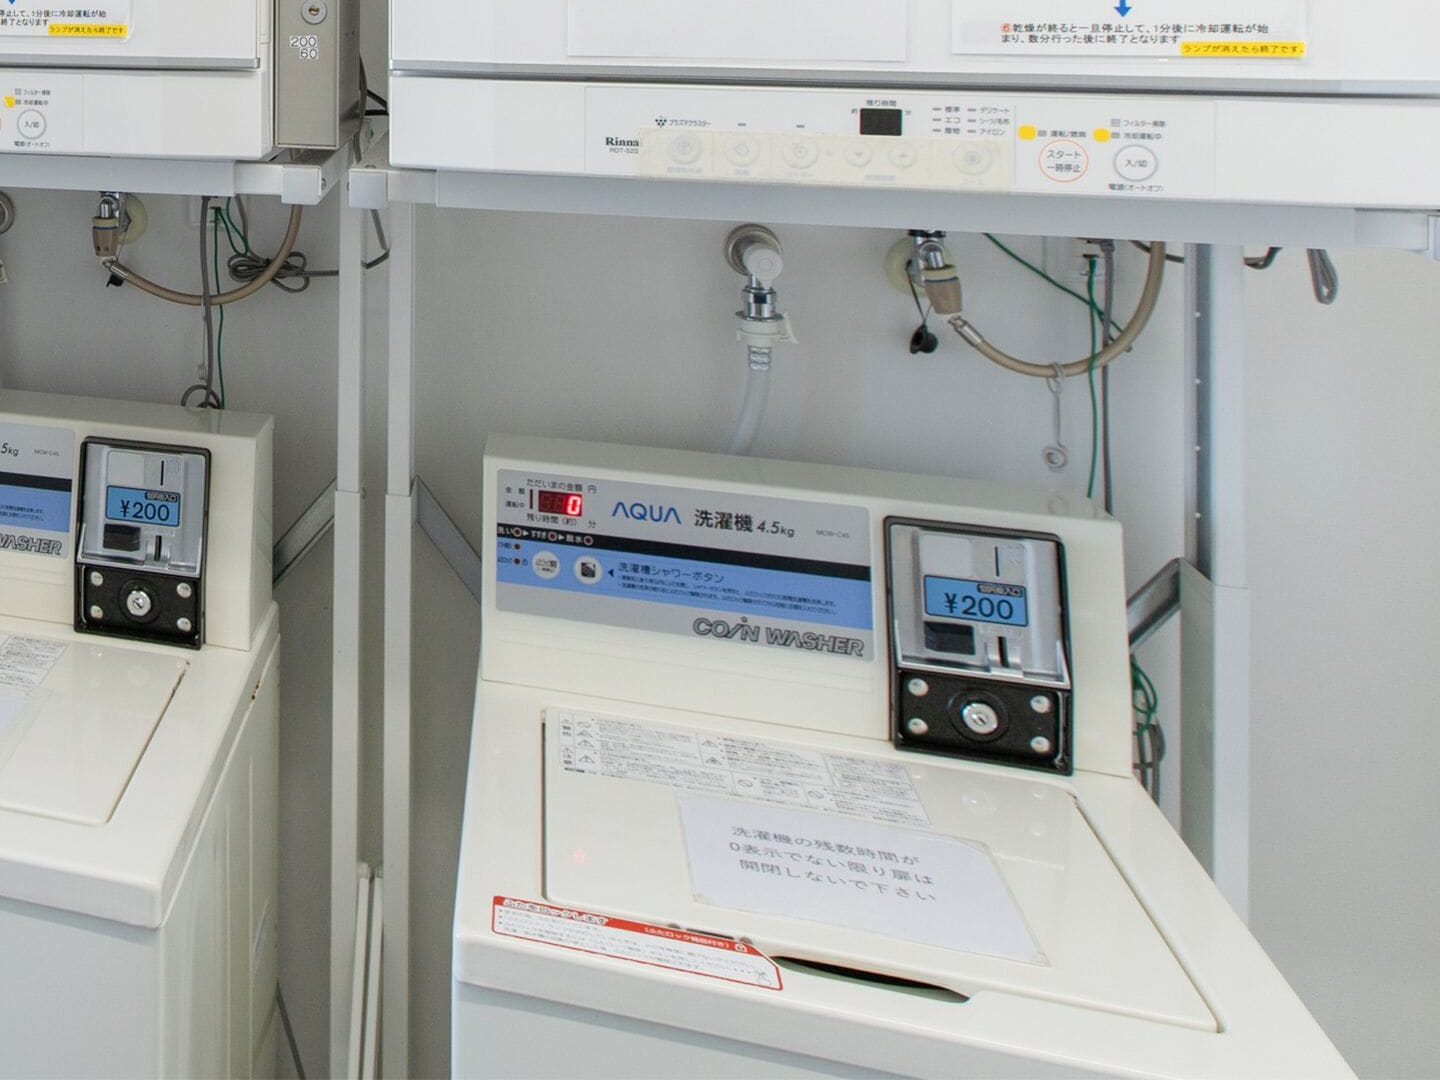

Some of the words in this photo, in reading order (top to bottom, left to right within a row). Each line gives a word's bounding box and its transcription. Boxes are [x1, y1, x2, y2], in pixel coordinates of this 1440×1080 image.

[290, 36, 317, 47] 200
[1001, 33, 1181, 44] まり、数分行った後に終了となります
[300, 48, 317, 59] 60
[866, 99, 897, 107] 残り時間
[980, 107, 1010, 115] デリケート
[668, 119, 712, 128] プラズマクラスター
[945, 116, 961, 124] エコ
[1046, 150, 1082, 160] スタート
[1046, 163, 1082, 174] 一時停止
[1124, 159, 1148, 169] 入/切
[526, 479, 583, 492] ただいまの金額
[588, 484, 597, 494] 円
[120, 499, 170, 522] ¥200
[567, 495, 581, 515] 0
[612, 501, 681, 524] AQUA
[526, 513, 559, 524] 残り時間
[694, 508, 754, 533] 洗濯機
[757, 519, 796, 539] 4.5kg
[618, 561, 725, 584] 洗濯槽シャワーボタン
[944, 592, 1014, 620] ¥200
[692, 616, 761, 642] COIN
[766, 627, 864, 658] WASHER
[731, 824, 921, 866] 洗濯機の残数時間が
[728, 840, 935, 887] 0表示でない限り扉は
[738, 858, 937, 903] 開閉しないで下さい
[503, 897, 608, 926] ふたをロックします
